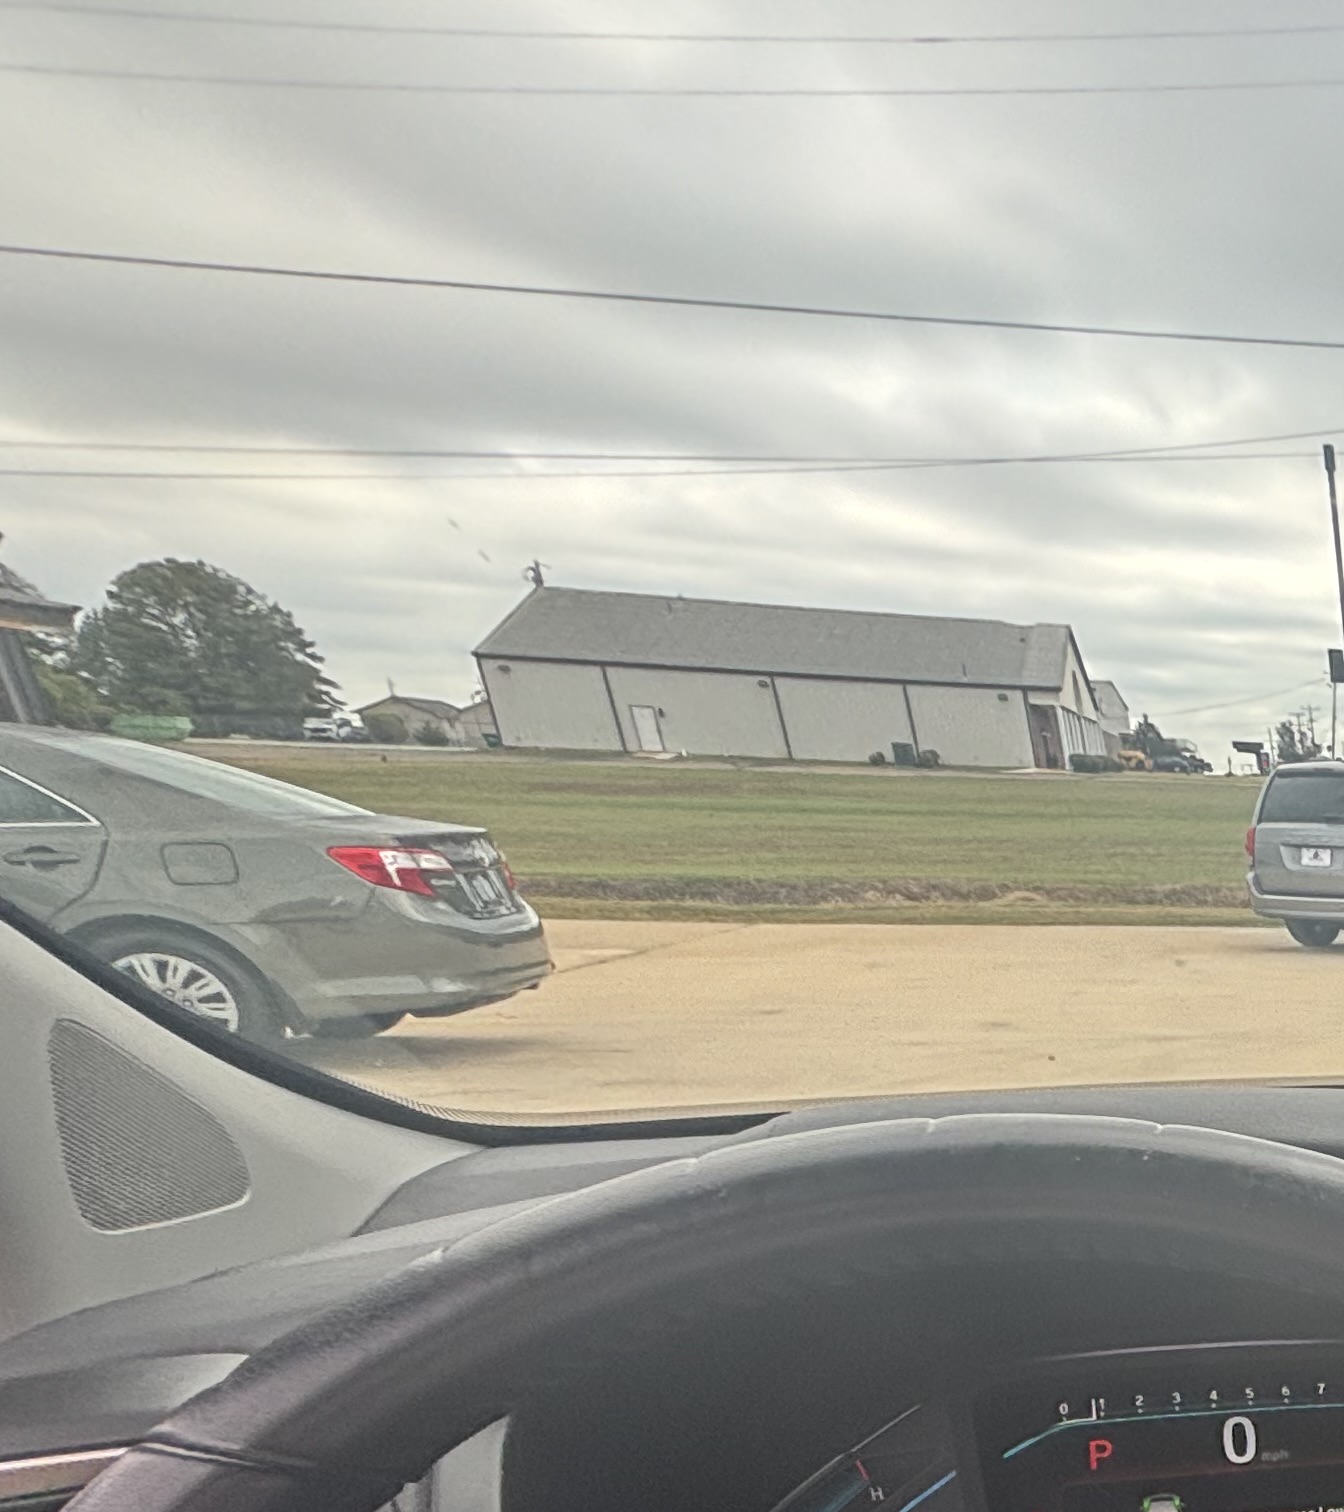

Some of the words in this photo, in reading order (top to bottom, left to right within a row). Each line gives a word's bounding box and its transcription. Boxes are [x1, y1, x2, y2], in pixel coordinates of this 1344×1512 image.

[1209, 1390, 1218, 1400] 4
[1245, 1387, 1254, 1399] 5
[1281, 1386, 1291, 1396] 6
[1316, 1383, 1325, 1395] 7
[1135, 1395, 1144, 1406] 2
[1172, 1392, 1181, 1403] 3
[1059, 1403, 1069, 1415] 0
[1223, 1416, 1257, 1464] 0
[1261, 1449, 1290, 1462] mph
[1088, 1439, 1113, 1470] P
[869, 1487, 885, 1501] H
